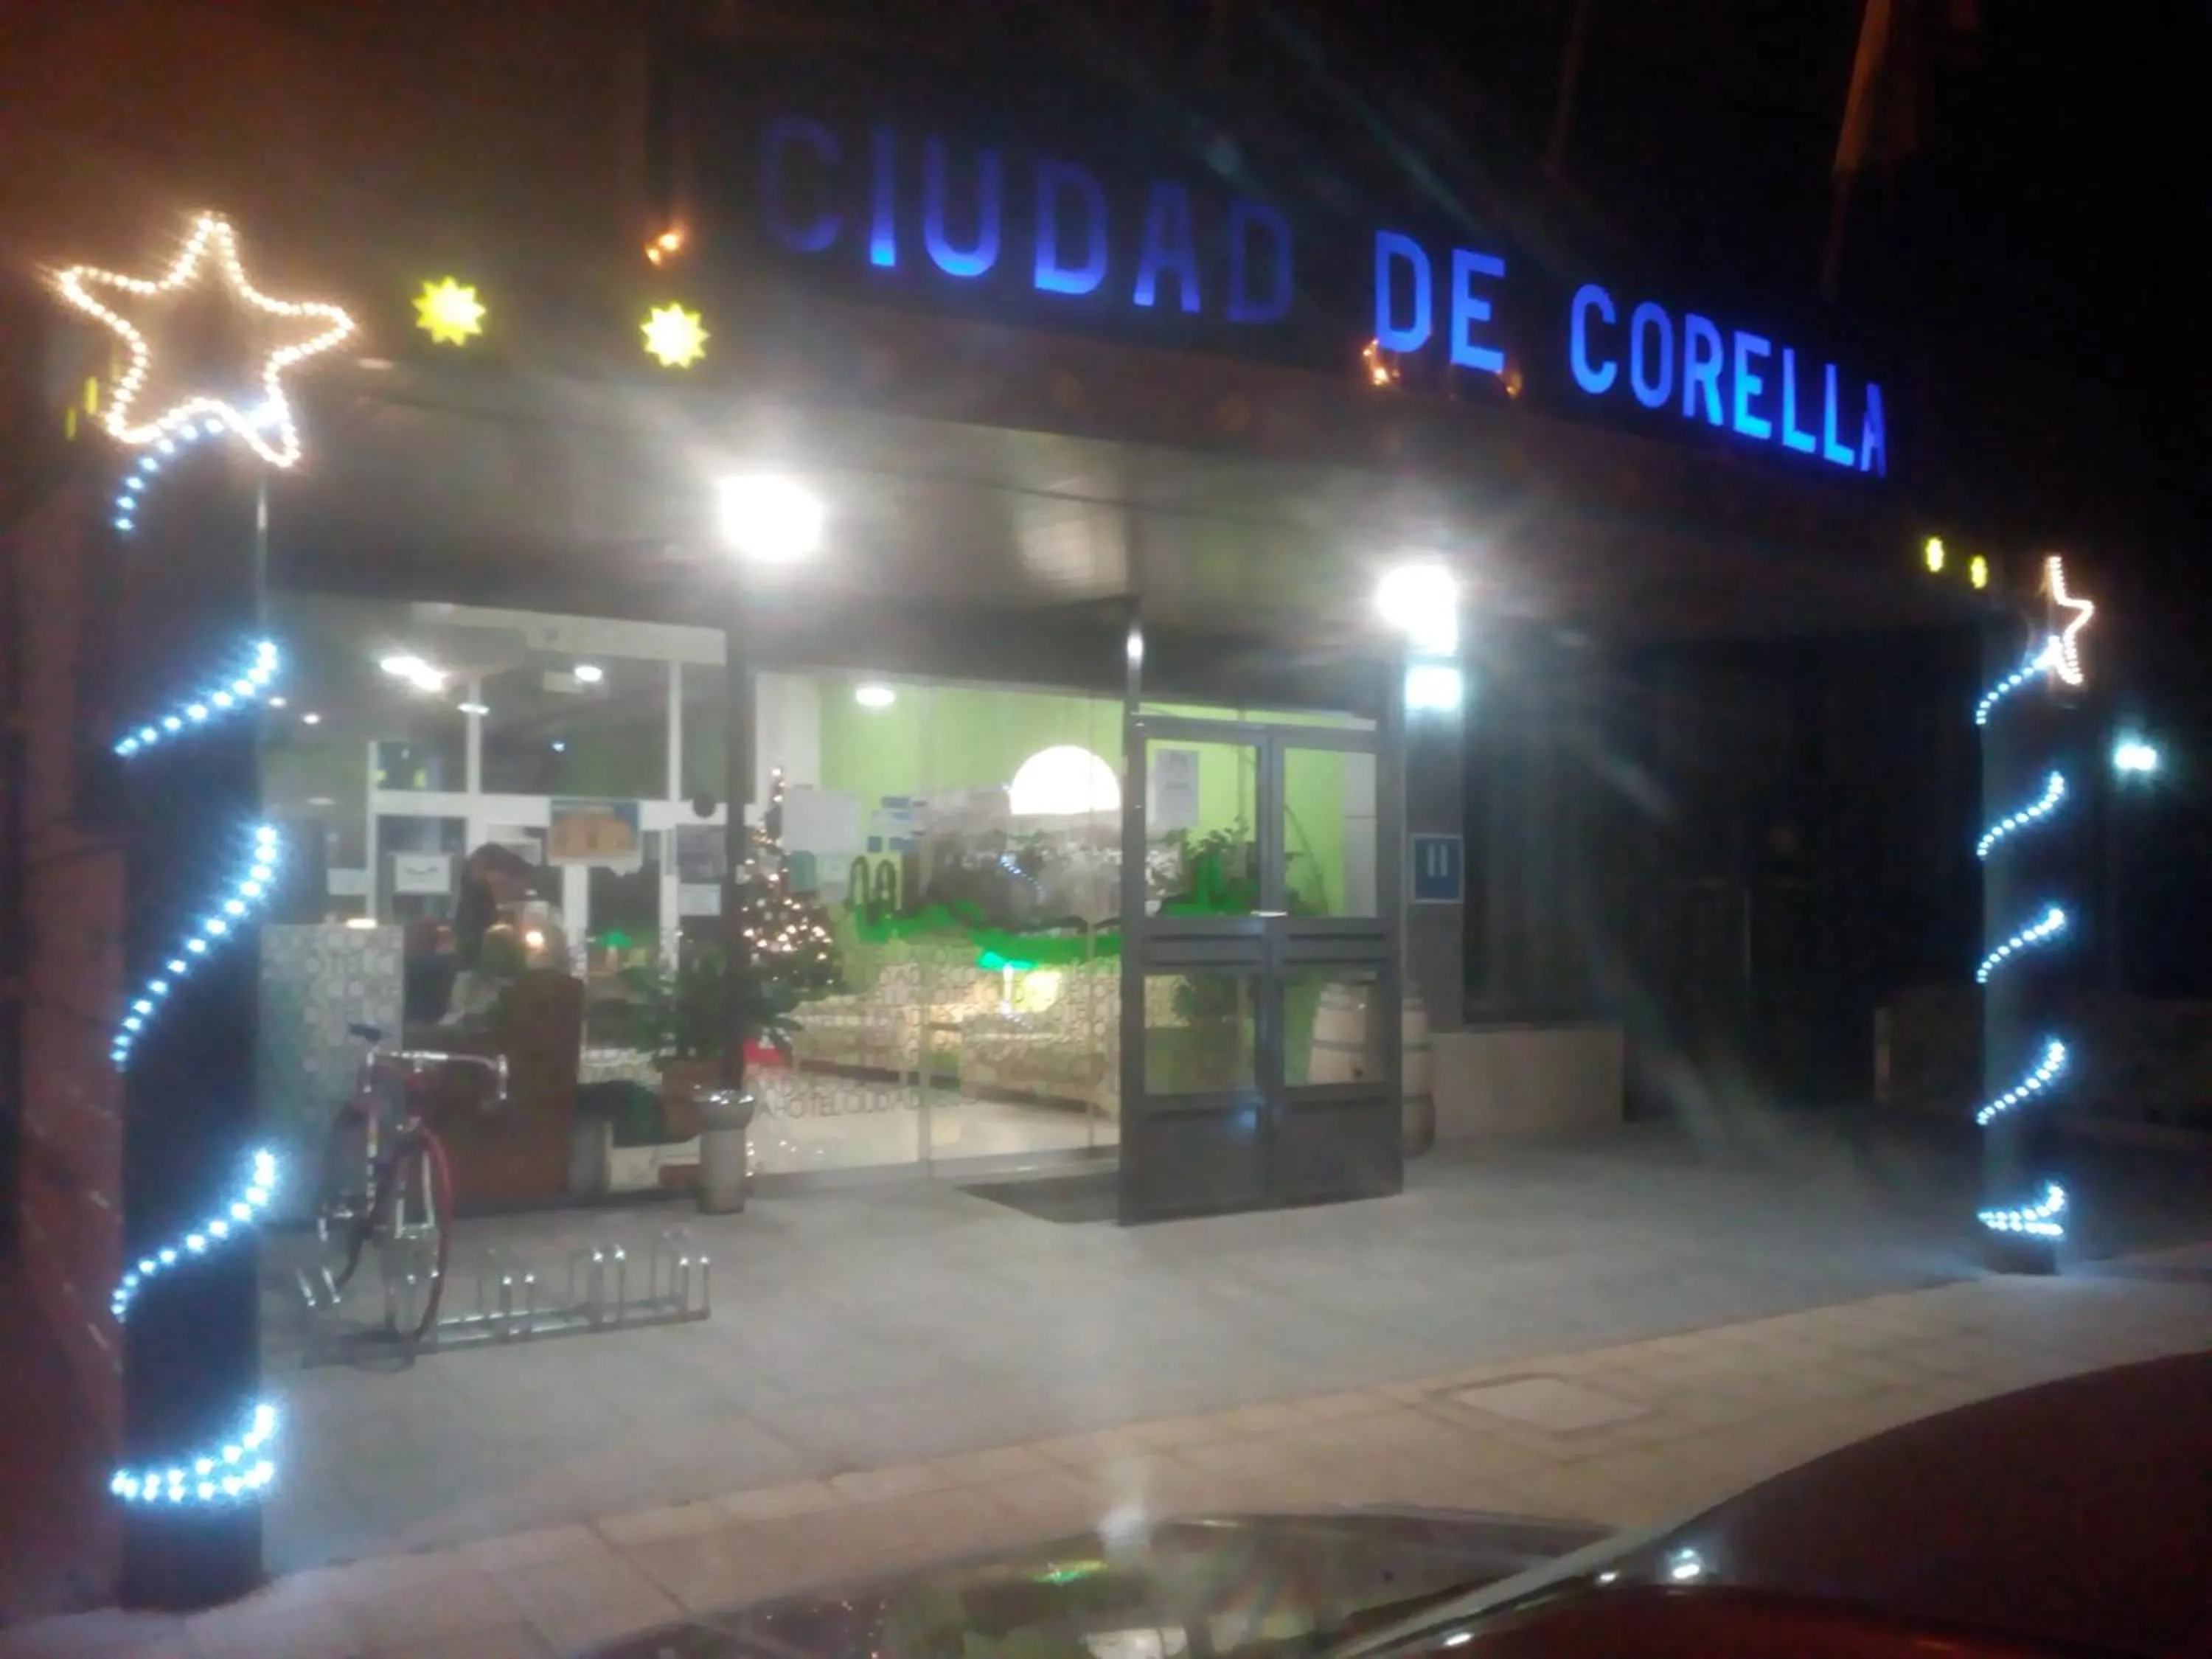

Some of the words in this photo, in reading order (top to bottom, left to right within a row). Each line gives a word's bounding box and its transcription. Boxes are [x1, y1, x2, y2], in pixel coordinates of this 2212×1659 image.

[760, 116, 1293, 324] CIUDAD
[1374, 229, 1506, 374] DE
[1569, 284, 1887, 479] CORELLA
